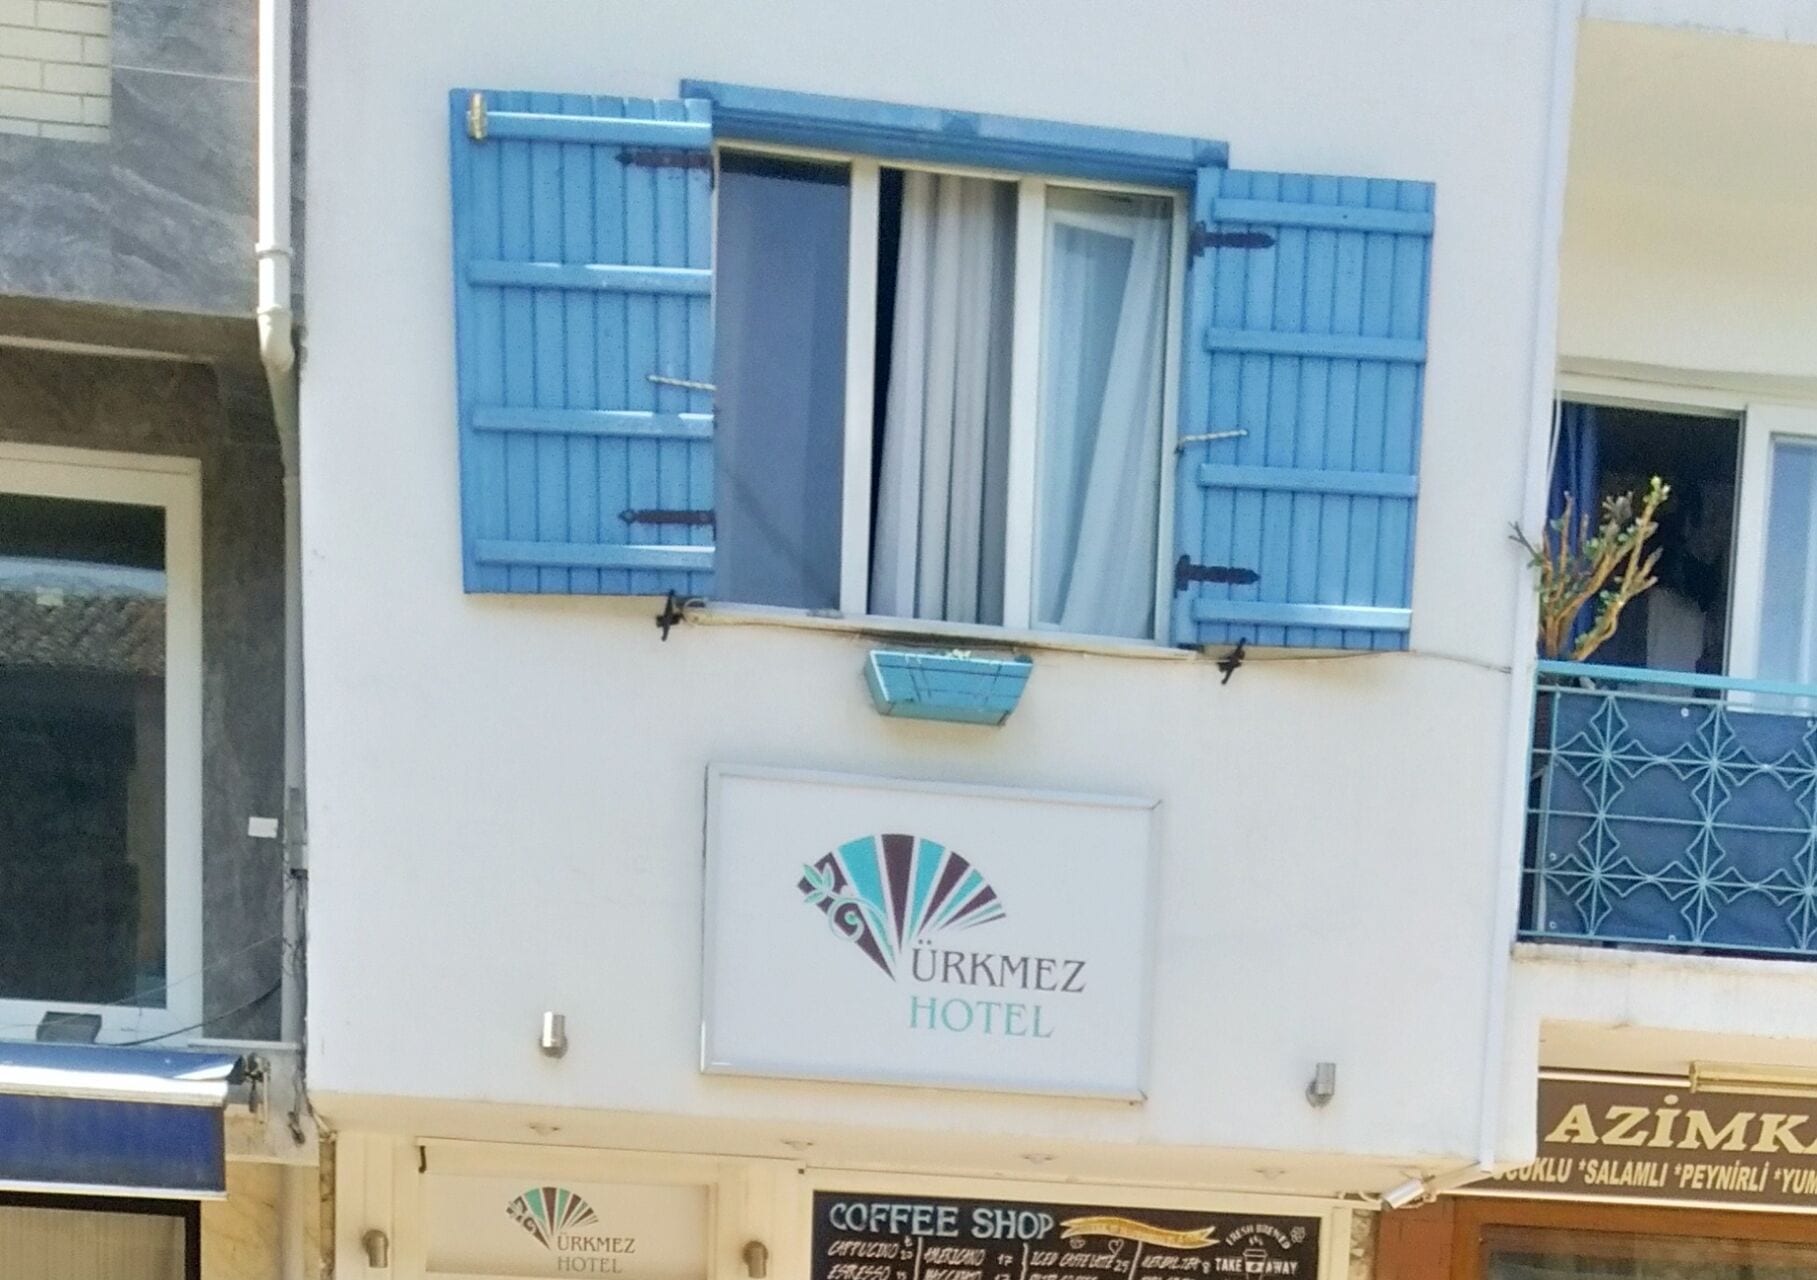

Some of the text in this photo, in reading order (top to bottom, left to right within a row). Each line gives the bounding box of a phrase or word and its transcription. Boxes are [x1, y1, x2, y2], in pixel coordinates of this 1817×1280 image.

[912, 939, 1087, 993] ÜRKMEZ
[909, 995, 1055, 1038] HOTEL
[1544, 1094, 1817, 1154] AZİMK
[829, 1202, 959, 1237] COFFEE
[971, 1208, 1054, 1240] SHOP
[556, 1232, 636, 1254] ÜRKMEZ
[556, 1256, 624, 1275] HOTEL
[997, 1253, 1014, 1267] 17
[1030, 1251, 1059, 1266] ICED
[1113, 1259, 1130, 1274] 25
[1214, 1257, 1299, 1275] TAKE AWAY
